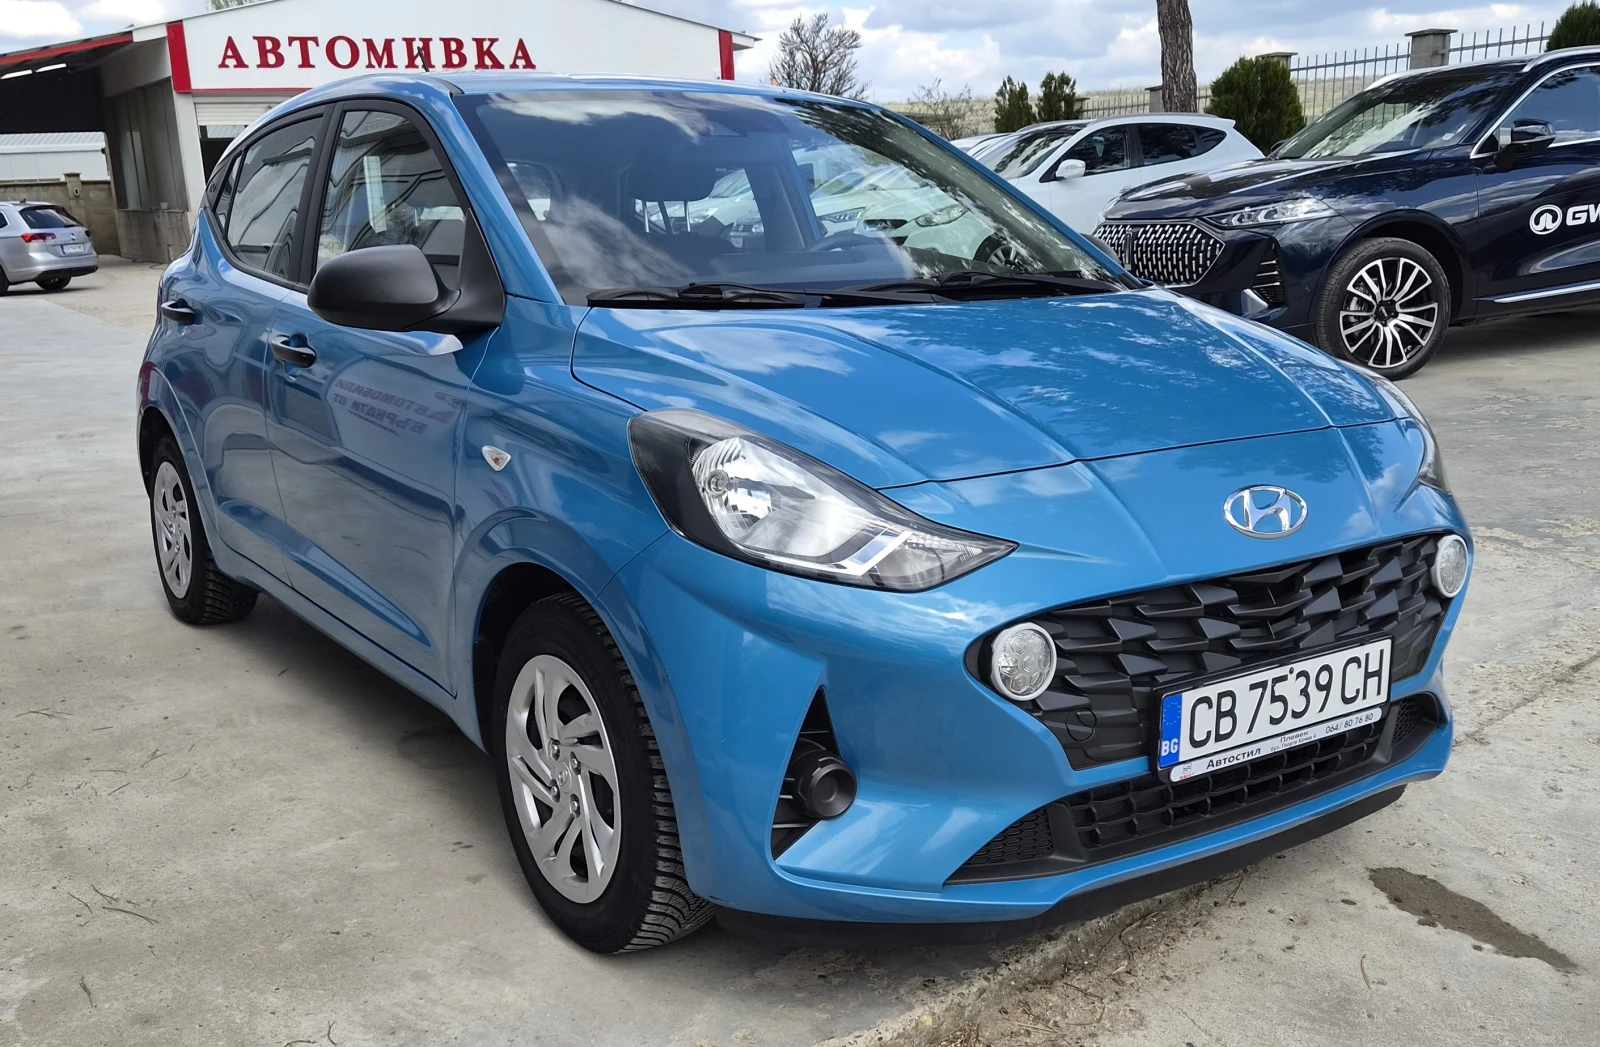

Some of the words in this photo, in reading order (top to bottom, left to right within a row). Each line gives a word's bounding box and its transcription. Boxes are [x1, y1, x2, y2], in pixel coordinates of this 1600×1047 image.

[217, 35, 537, 70] АВТОМИВКА
[1246, 664, 1334, 735] 7539
[1161, 738, 1179, 757] BG
[1280, 731, 1309, 744] Плевен
[1206, 747, 1261, 770] Автостил
